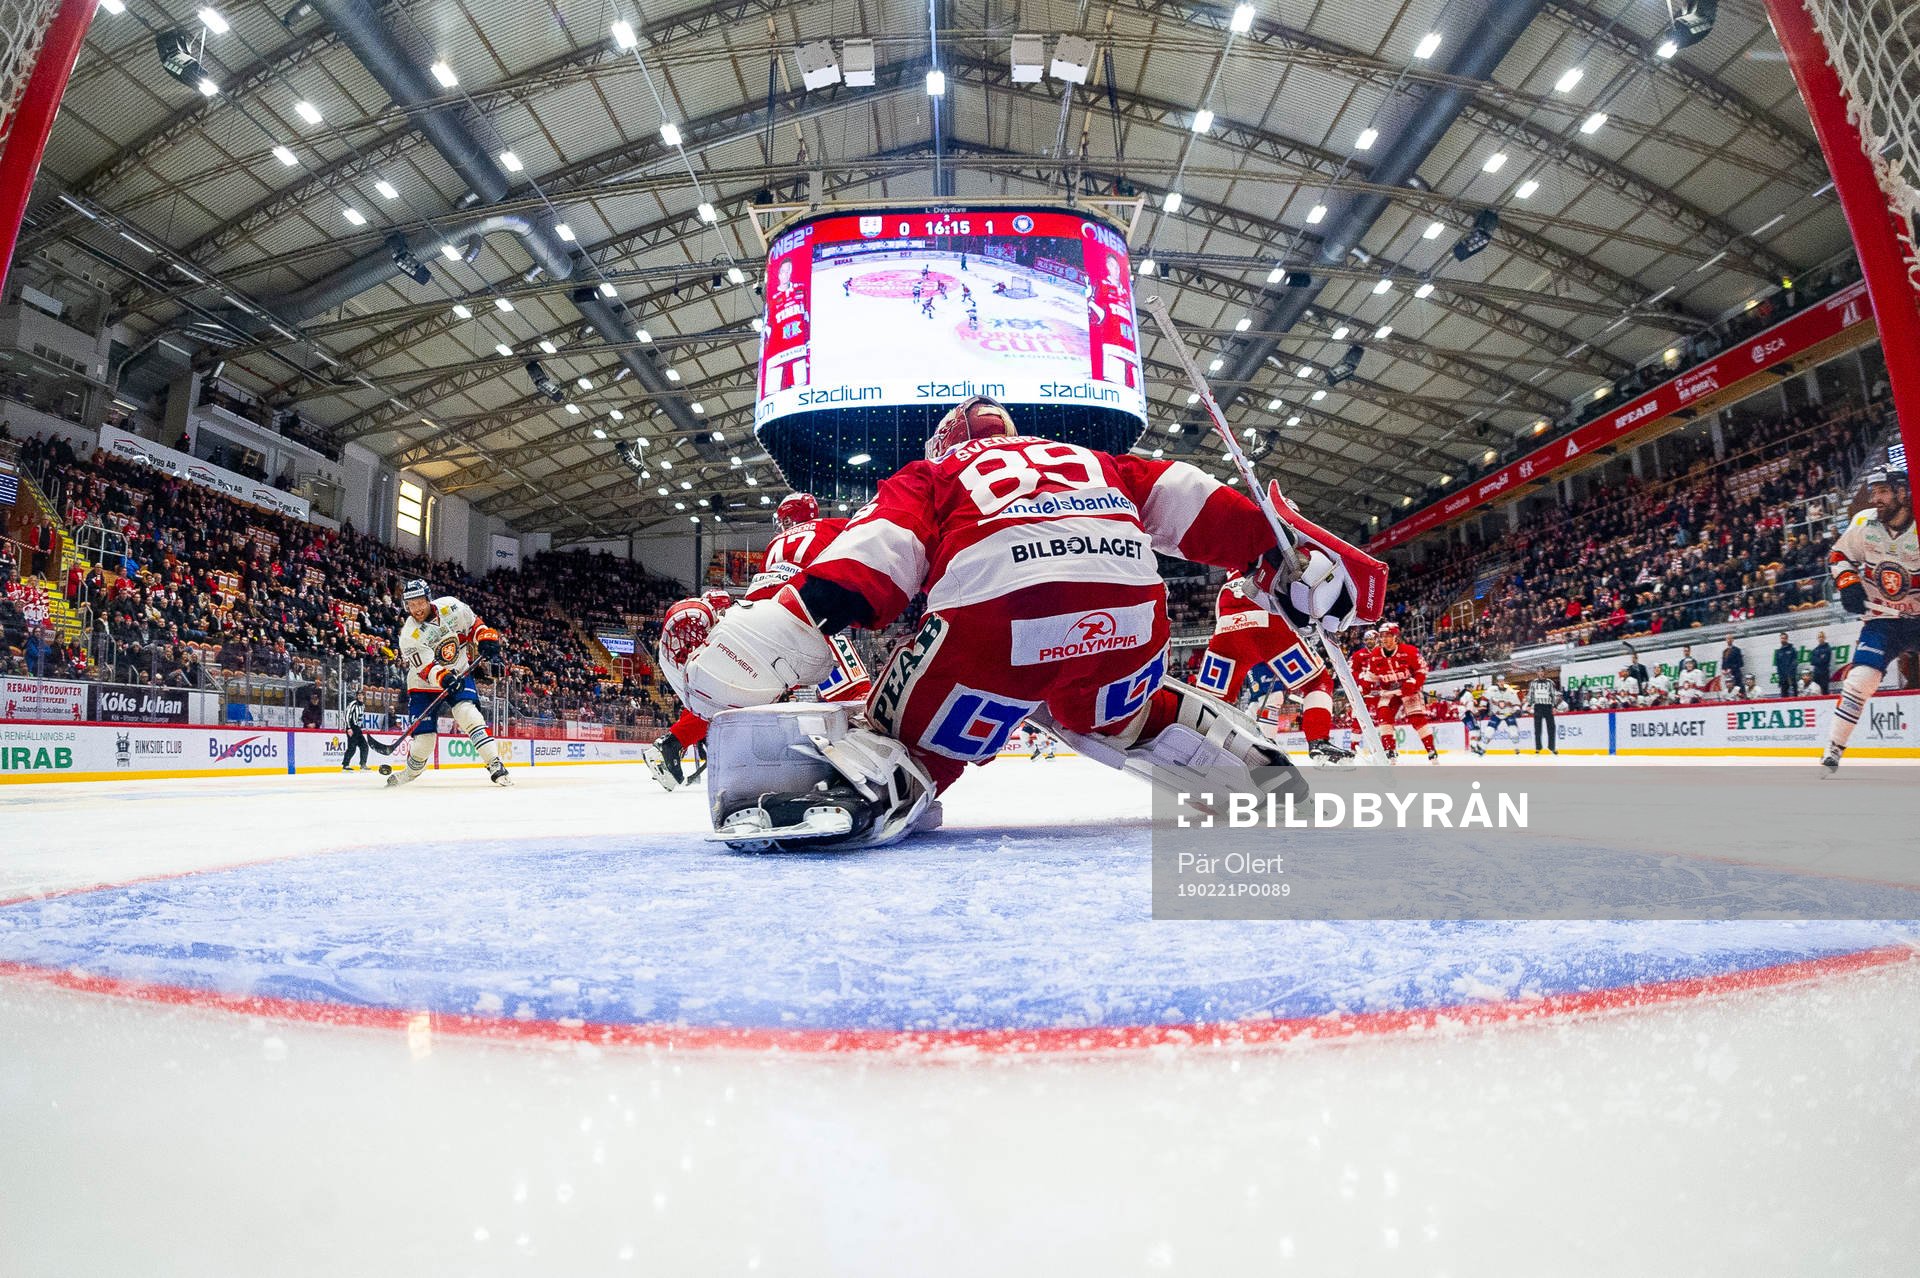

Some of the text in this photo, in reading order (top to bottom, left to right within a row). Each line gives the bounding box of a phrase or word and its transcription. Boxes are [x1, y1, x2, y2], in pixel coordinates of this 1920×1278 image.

[899, 222, 910, 236] 0
[925, 220, 970, 235] 16:15
[985, 220, 994, 234] 1
[1764, 338, 1787, 355] SCA
[799, 385, 882, 406] stadium
[917, 380, 1005, 398] stadium
[1040, 381, 1120, 404] stadium
[113, 441, 177, 470] Faradium Bygg AB
[188, 468, 216, 484] Faradium
[234, 486, 243, 494] AB
[958, 442, 1108, 515] 89
[1001, 492, 1137, 515] andelsbanken
[765, 530, 816, 572] 47
[1011, 536, 1142, 564] BILBOLAGET
[716, 642, 753, 675] PREMIER
[1039, 635, 1138, 661] PROLYMPIA
[874, 614, 942, 733] PEAB
[7, 683, 82, 696] REBAND PRODUKTER
[100, 692, 182, 714] Köks Johan
[1630, 720, 1706, 738] BILBOLAGET
[1737, 709, 1805, 730] PEAB
[4, 729, 64, 741] RENHÅLLNINGS
[64, 732, 76, 741] AB
[1567, 727, 1583, 737] SCA
[135, 740, 182, 754] RINKSIDE CLUB
[209, 737, 278, 763] Bussgods
[567, 744, 586, 758] SSE
